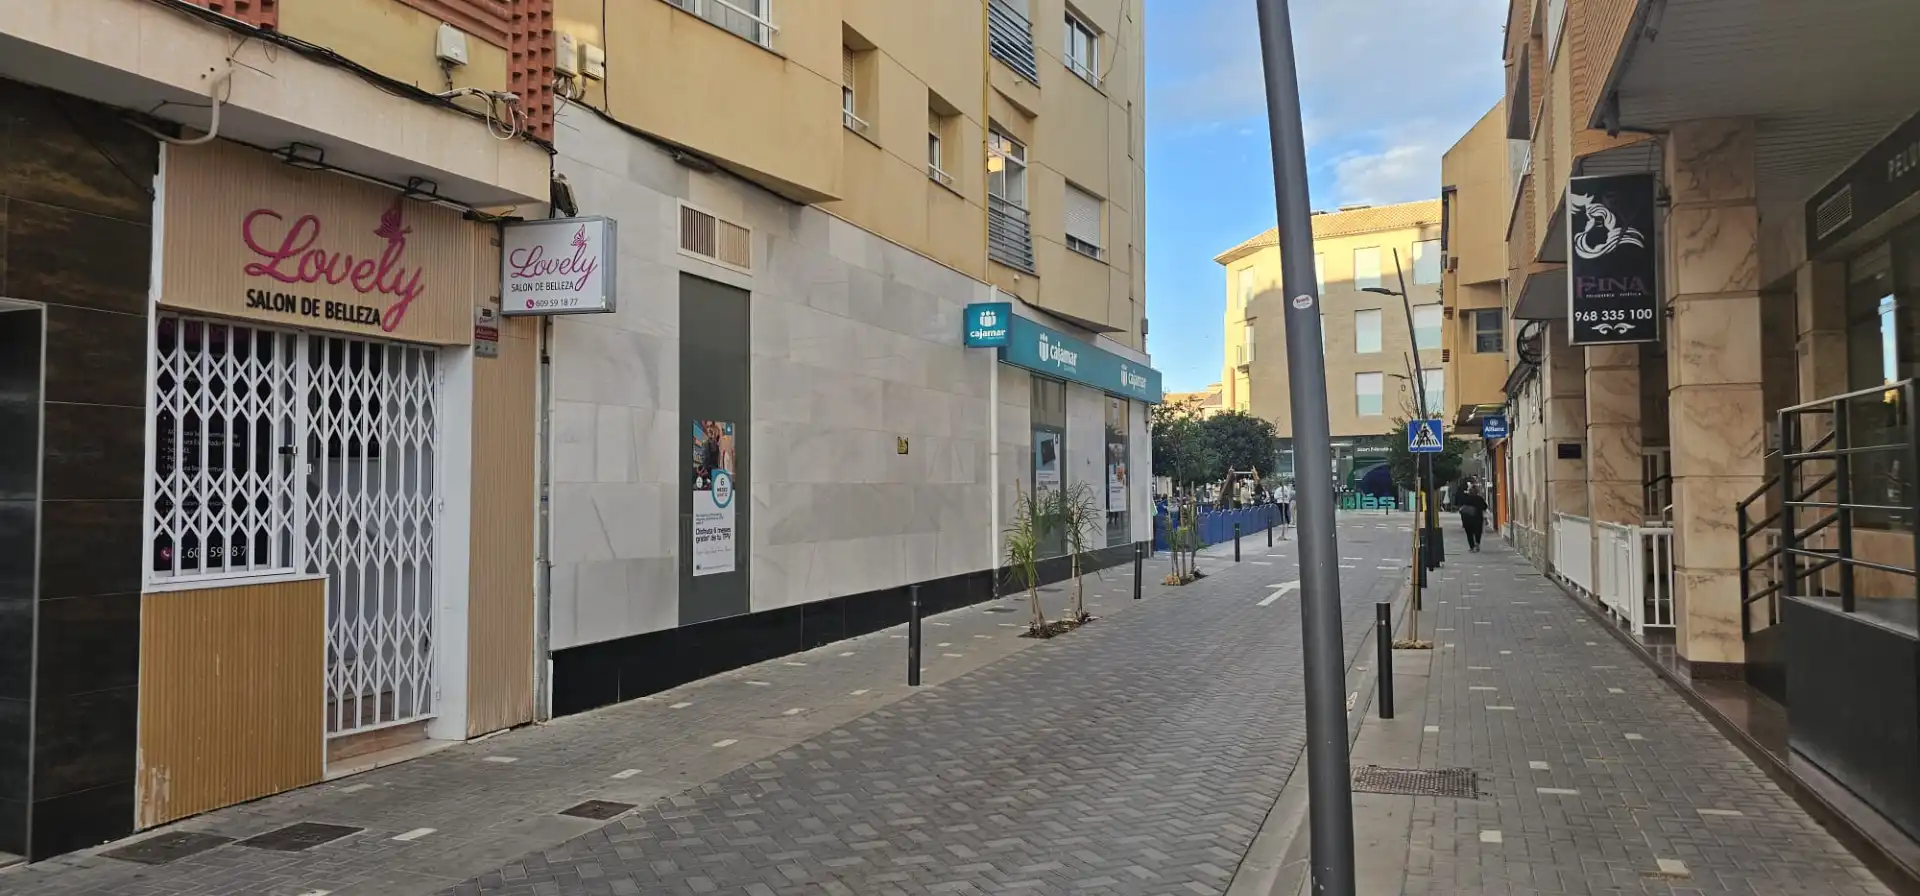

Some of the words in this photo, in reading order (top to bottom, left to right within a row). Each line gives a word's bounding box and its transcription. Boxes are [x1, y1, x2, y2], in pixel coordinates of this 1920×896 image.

[243, 208, 424, 332] Lovely
[509, 245, 598, 292] Lovely
[511, 282, 533, 292] SALON
[535, 282, 544, 291] DE
[546, 281, 574, 291] BELLEZA
[246, 288, 297, 314] SALON
[301, 297, 321, 317] DE
[325, 301, 381, 326] BELLEZA
[536, 300, 549, 308] 609
[550, 299, 559, 307] 59
[561, 299, 569, 307] 18
[1575, 310, 1598, 321] 968
[1601, 309, 1625, 321] 335
[1630, 308, 1652, 320] 100
[970, 328, 1006, 340] cajamar
[1050, 341, 1078, 368] cajamar
[1128, 369, 1147, 390] cajamar
[720, 478, 725, 486] 6
